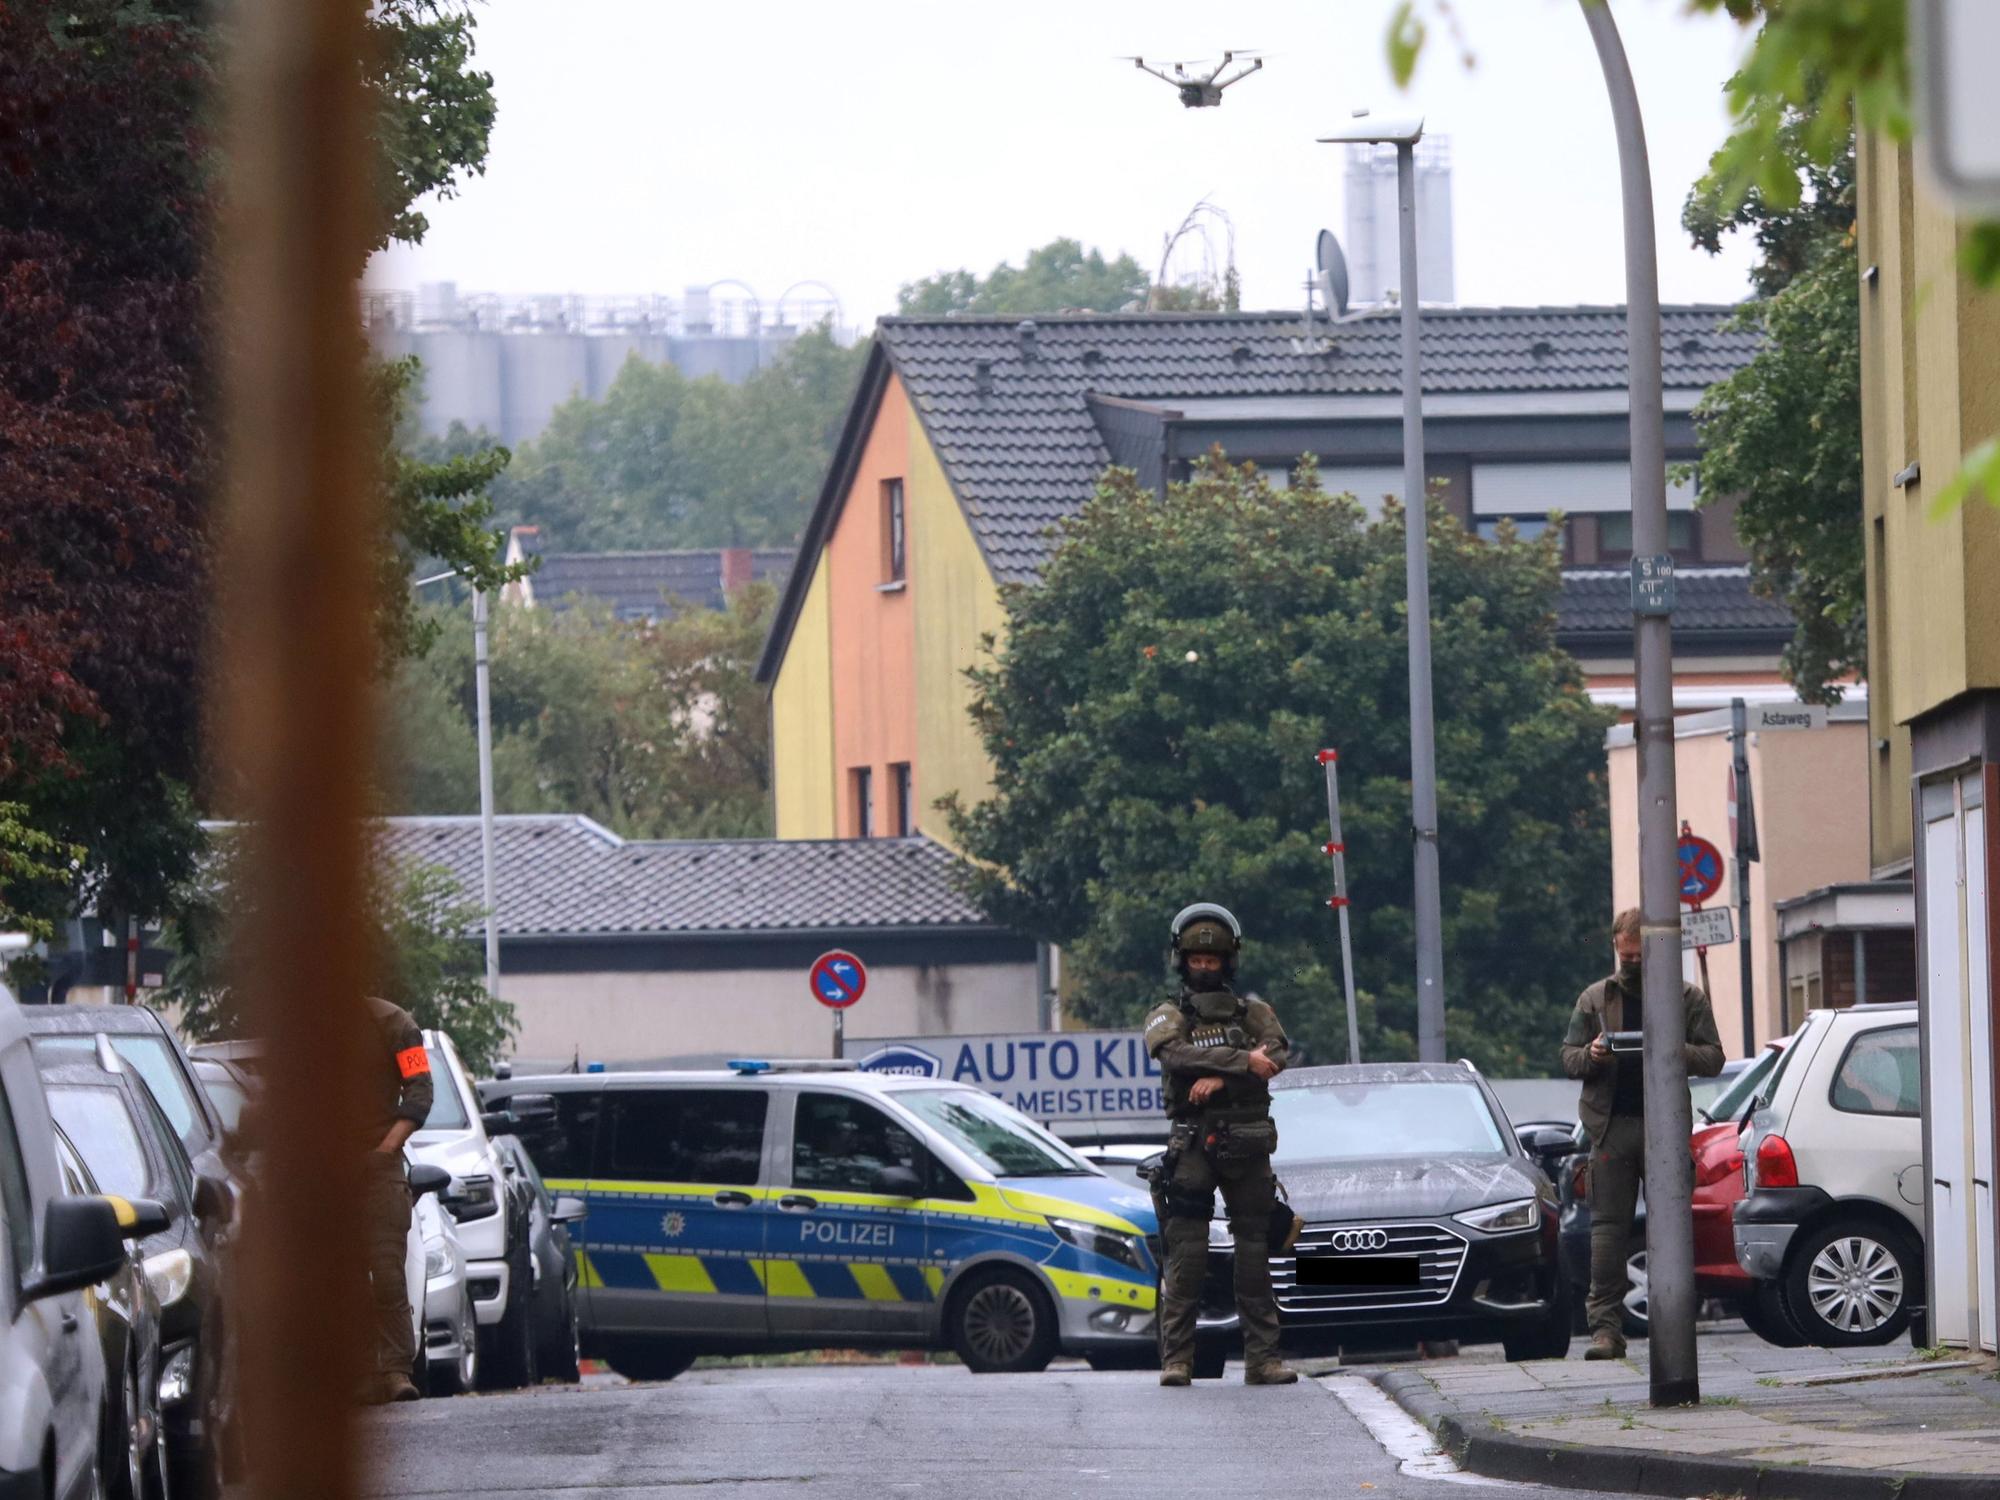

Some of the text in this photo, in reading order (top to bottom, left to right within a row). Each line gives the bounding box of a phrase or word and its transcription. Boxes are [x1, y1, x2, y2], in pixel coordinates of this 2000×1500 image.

[1642, 562, 1652, 576] S
[1761, 711, 1811, 729] Astaweg
[952, 1039, 1080, 1083] AUTO
[800, 1220, 895, 1246] POLIZEI
